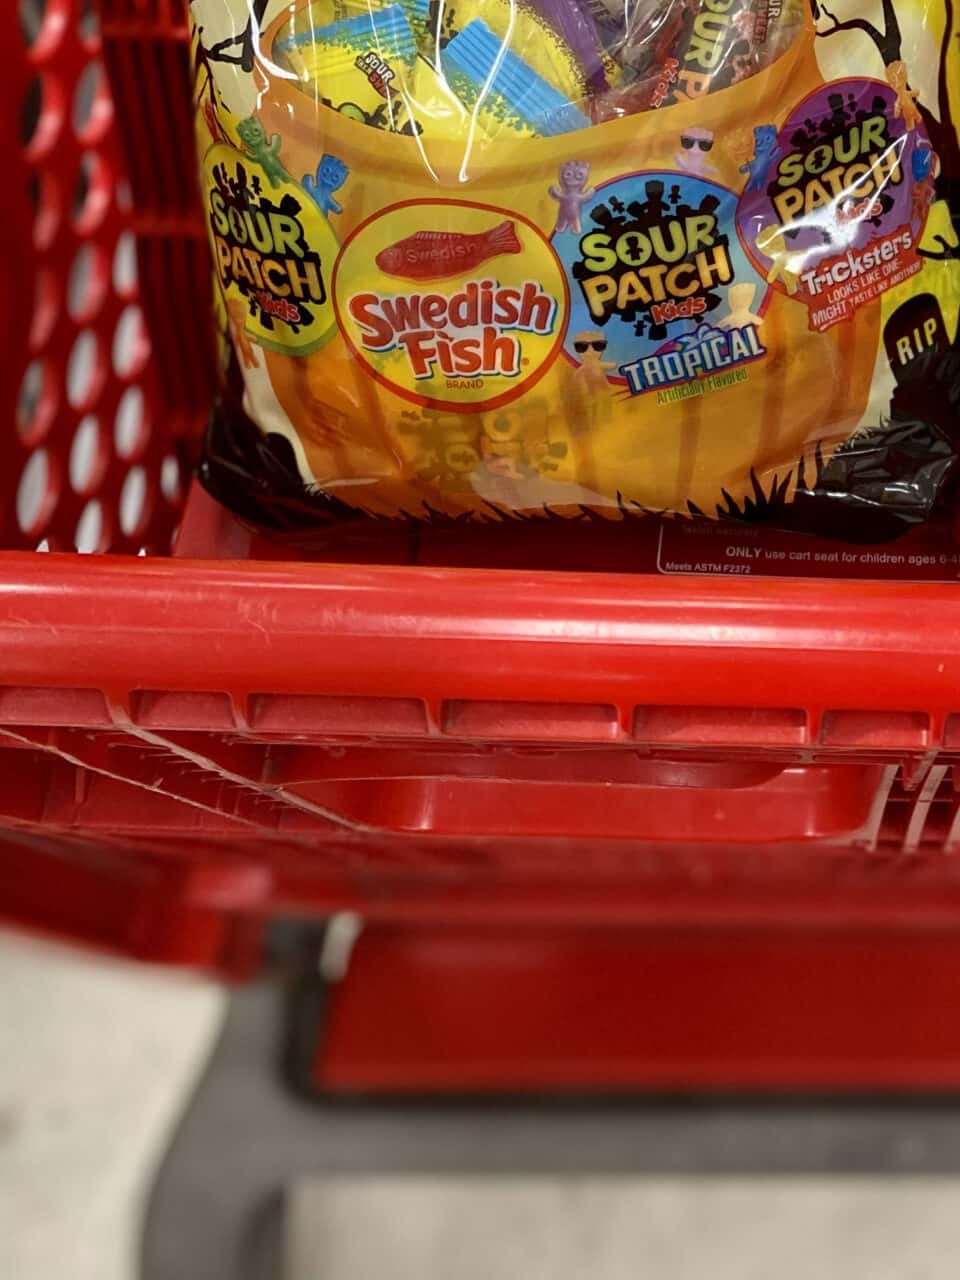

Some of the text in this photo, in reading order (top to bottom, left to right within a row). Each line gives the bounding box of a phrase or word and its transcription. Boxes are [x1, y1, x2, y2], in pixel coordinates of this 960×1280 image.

[365, 54, 393, 83] SOUR
[777, 115, 887, 187] SOUR
[773, 149, 902, 225] PATCH
[211, 191, 305, 258] SOUR
[405, 239, 478, 264] Swedish
[581, 215, 718, 272] SOUR
[215, 236, 323, 301] PATCH
[581, 244, 731, 318] PATCH
[801, 230, 913, 297] Tricksters
[827, 281, 860, 304] LOOKS
[860, 269, 881, 288] LIKE
[349, 280, 554, 350] Swedish
[812, 300, 848, 327] MIGHT
[849, 288, 874, 308] TASTE
[398, 325, 519, 377] Fish
[622, 324, 766, 394] TROPICAL
[896, 317, 939, 366] RIP
[446, 379, 484, 390] BRAND
[694, 562, 721, 573] ASTM
[726, 545, 762, 559] ONLY
[765, 550, 786, 561] use
[788, 549, 811, 561] cart
[814, 551, 839, 563] seat
[841, 550, 858, 563] for
[859, 551, 905, 565] children
[908, 554, 936, 567] ages
